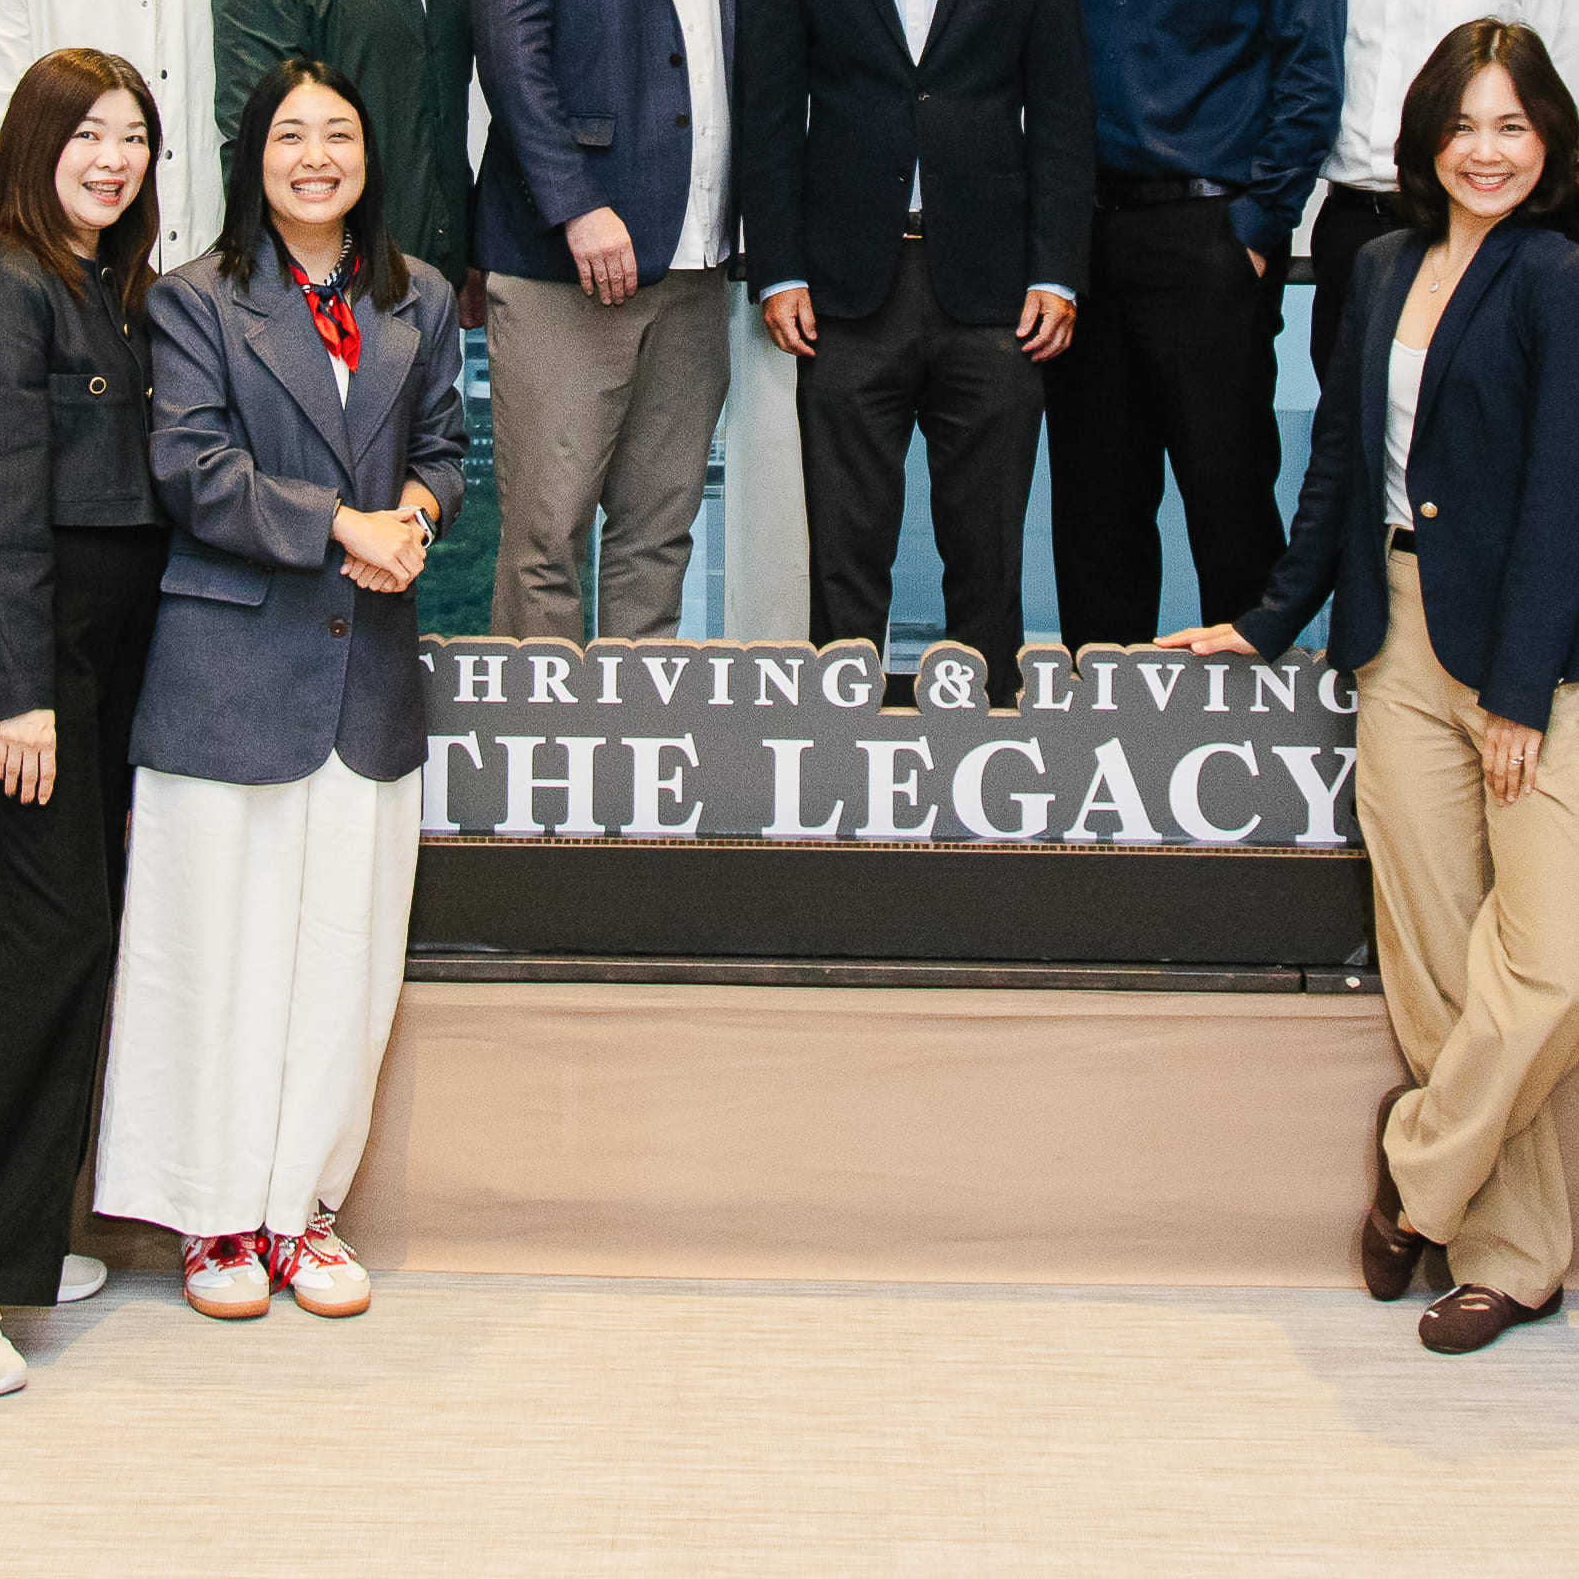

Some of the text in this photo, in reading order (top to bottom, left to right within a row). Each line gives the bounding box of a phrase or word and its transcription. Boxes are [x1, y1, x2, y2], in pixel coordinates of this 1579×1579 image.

[928, 659, 977, 710] &
[1032, 661, 1358, 714] LIVING
[420, 730, 1358, 843] THE LEGACY
